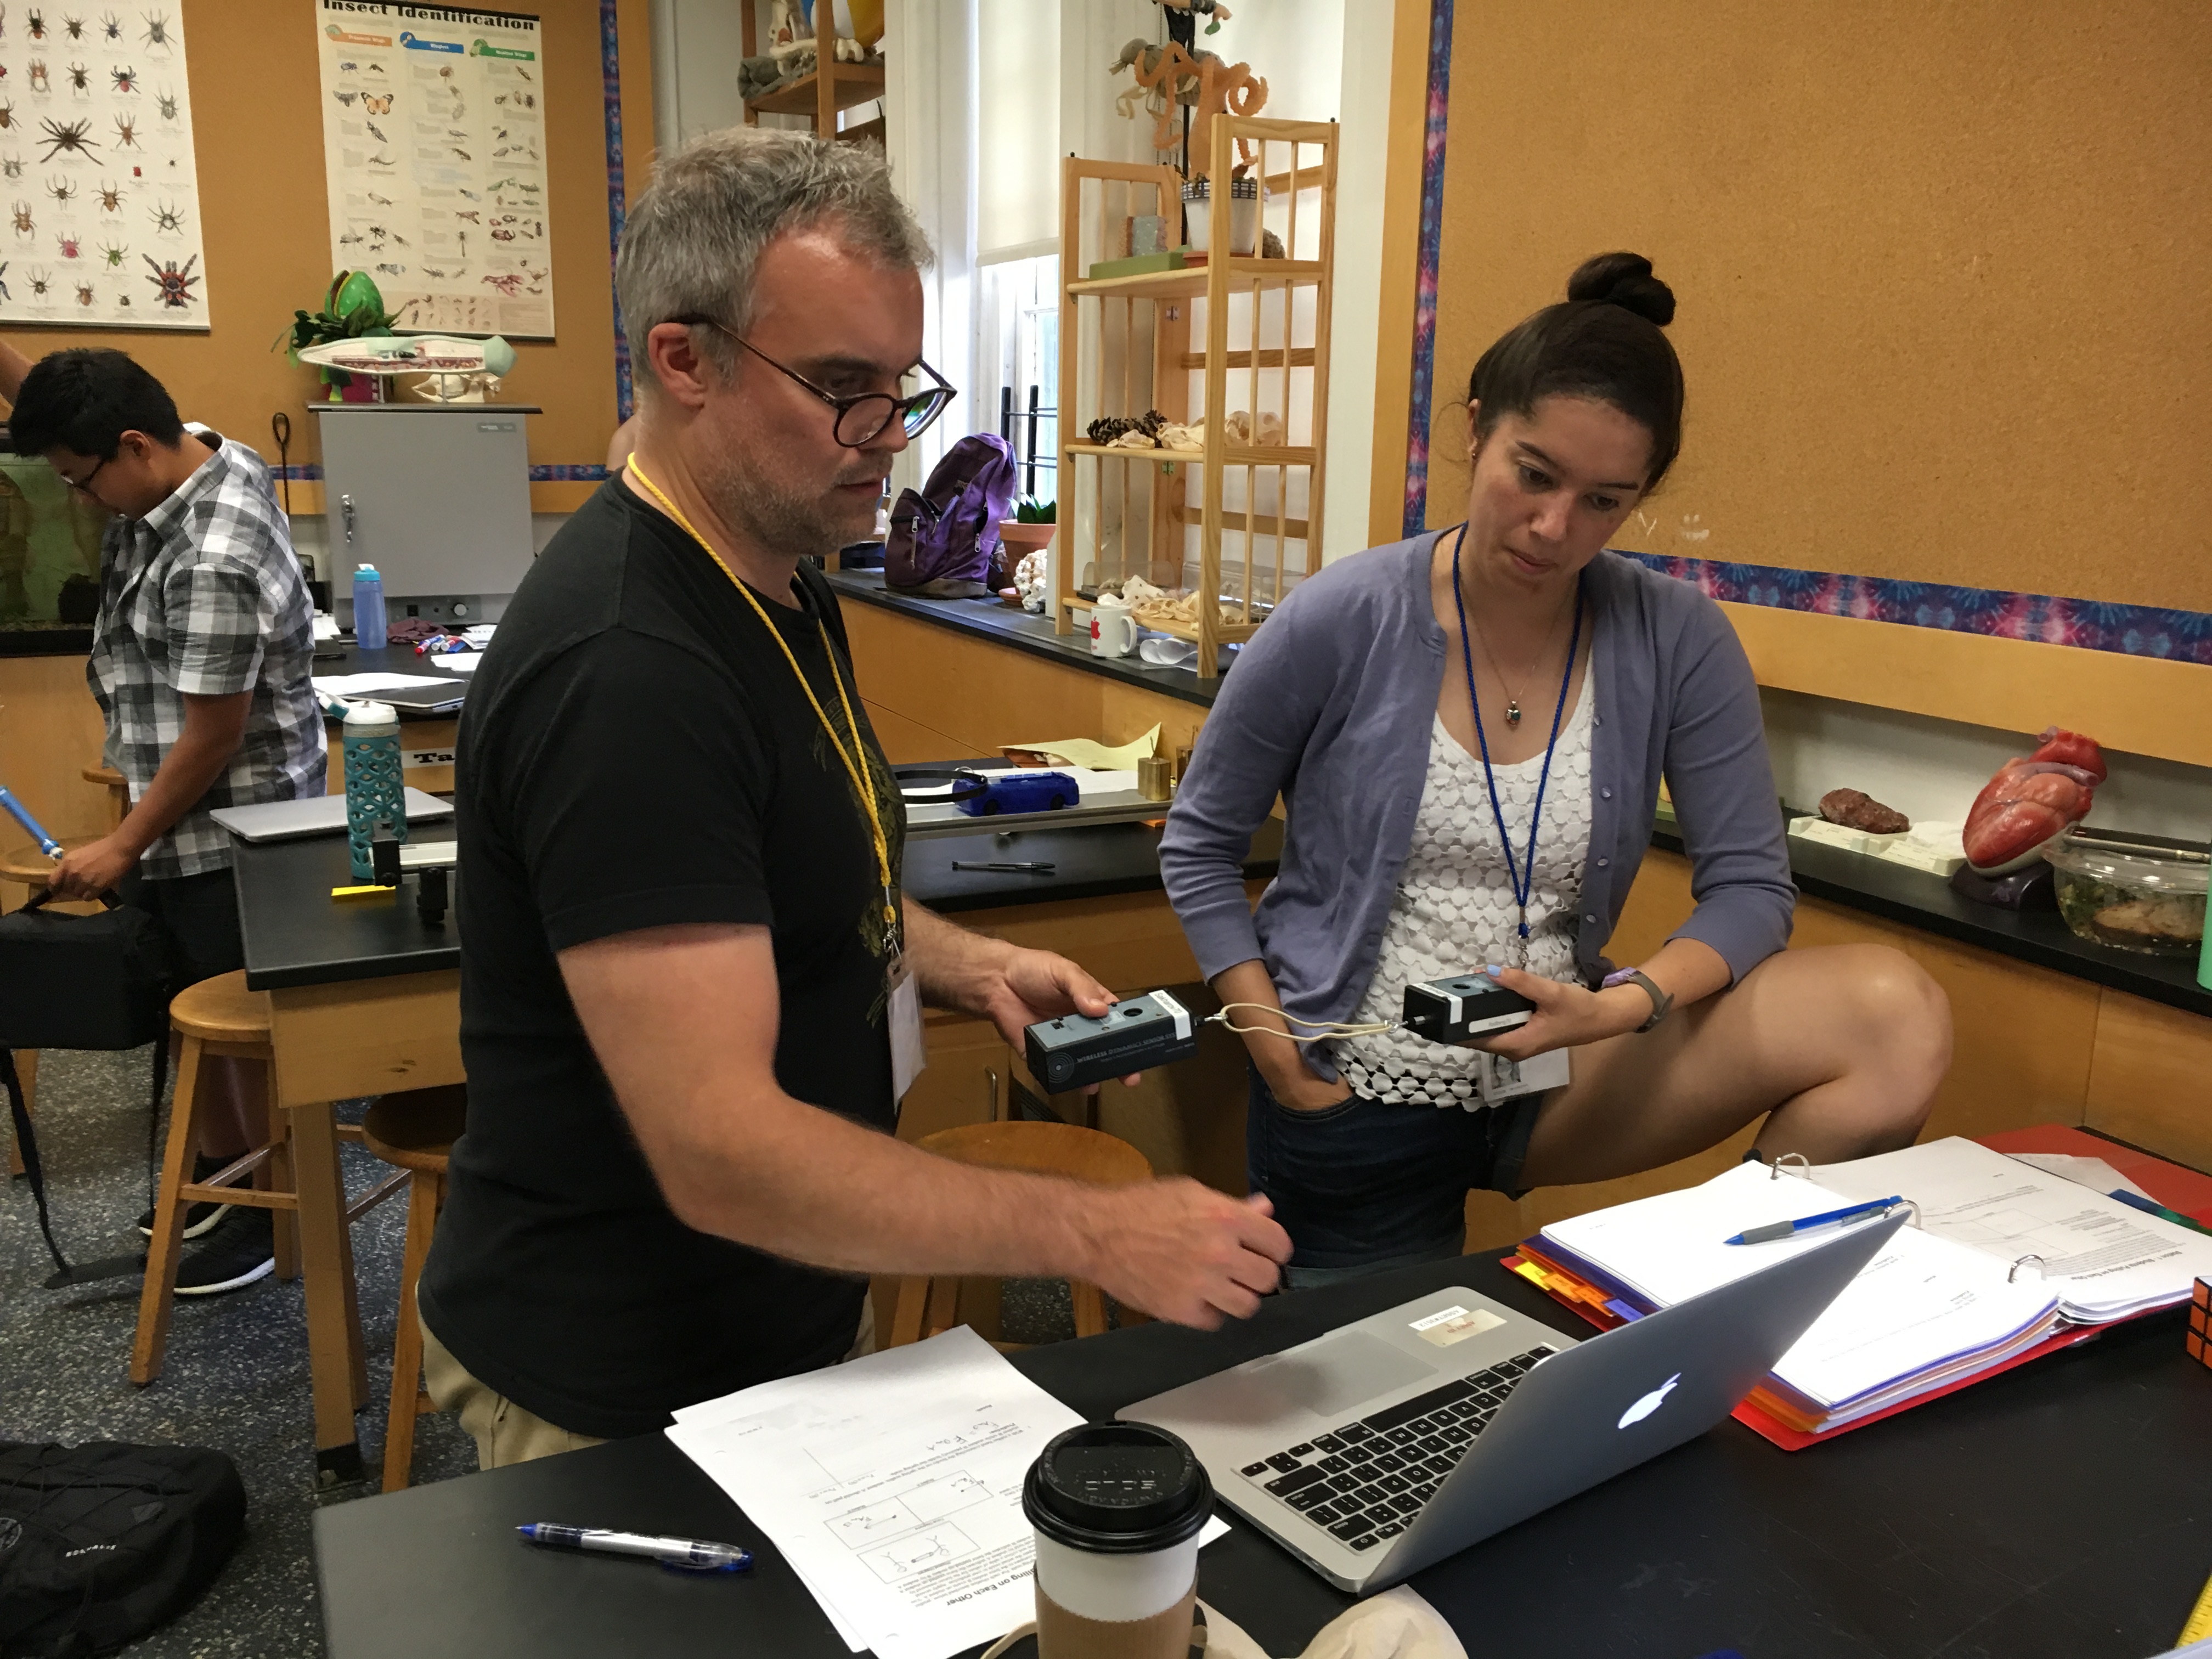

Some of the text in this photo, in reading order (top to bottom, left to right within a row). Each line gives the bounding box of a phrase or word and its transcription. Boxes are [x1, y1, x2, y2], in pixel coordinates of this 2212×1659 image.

[324, 0, 388, 15] Insect
[397, 5, 535, 30] Identification
[414, 753, 455, 763] Ta
[1076, 1051, 1107, 1063] WIRELESS
[973, 1584, 998, 1595] Each
[946, 1593, 973, 1605] Other
